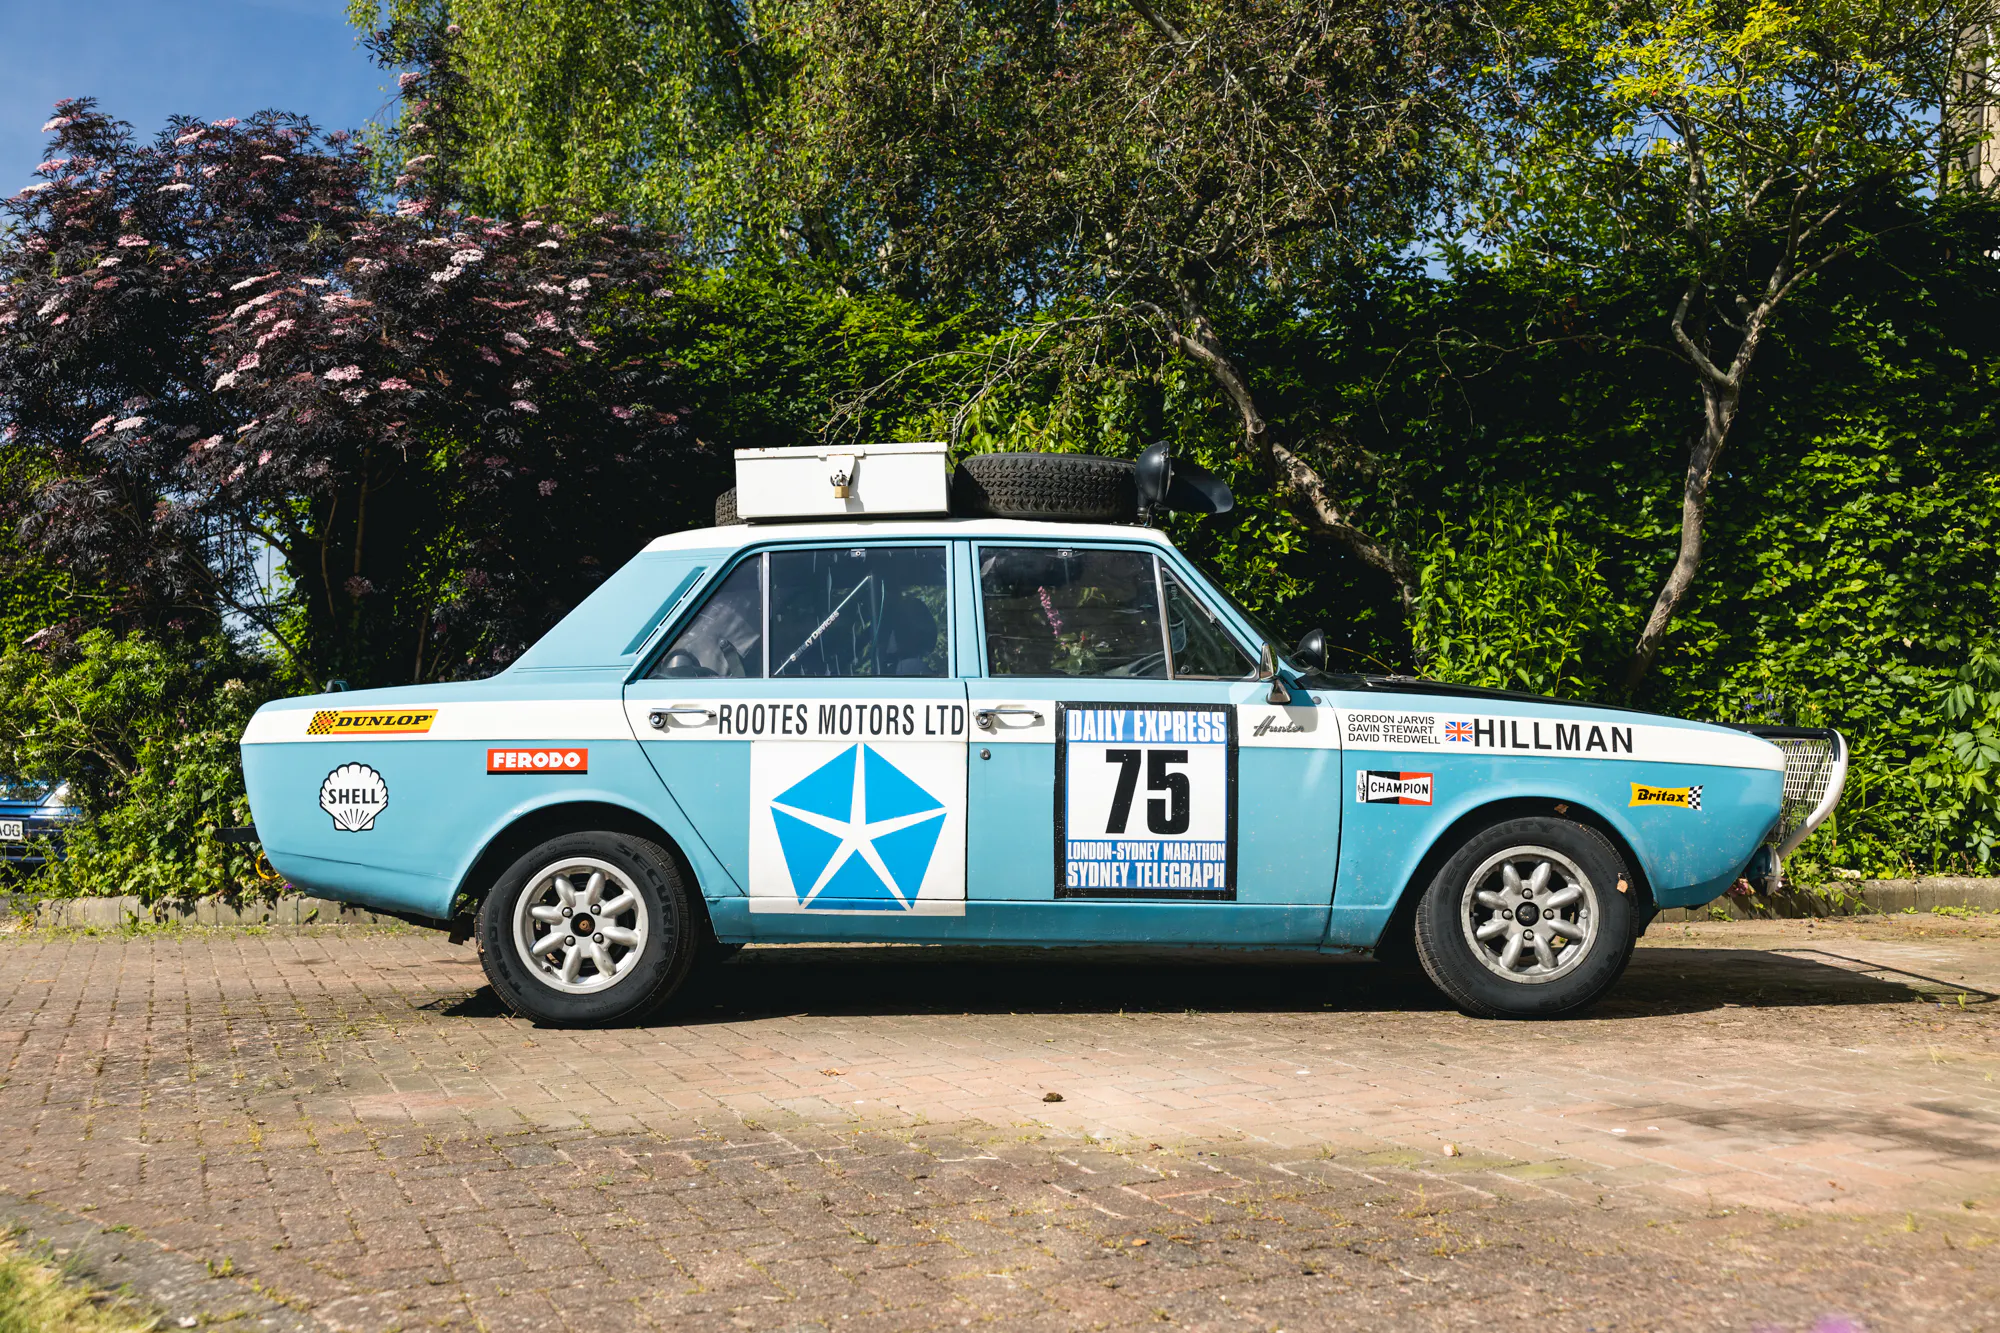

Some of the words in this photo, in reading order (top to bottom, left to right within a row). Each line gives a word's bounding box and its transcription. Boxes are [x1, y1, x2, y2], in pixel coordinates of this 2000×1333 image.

[811, 610, 840, 640] Devices
[335, 715, 430, 727] DUNLOP
[718, 703, 808, 735] ROOTES
[818, 704, 915, 735] MOTORS
[925, 705, 964, 735] LTD
[1068, 709, 1126, 741] DAILY
[1133, 711, 1226, 742] EXPRESS
[1252, 715, 1305, 737] Hunter
[1347, 714, 1395, 724] GORDON
[1397, 715, 1435, 725] JARVIS
[1347, 723, 1380, 733] GAVIN
[1382, 724, 1434, 735] STEWART
[1347, 733, 1380, 743] DAVID
[1382, 734, 1441, 745] TREDWELL
[1473, 718, 1633, 753] HILLMAN
[493, 752, 581, 768] FERODO
[328, 788, 380, 804] SHELL
[1105, 749, 1190, 835] 75
[1370, 781, 1429, 794] CHAMPION
[1637, 788, 1686, 803] Britax
[1067, 841, 1160, 860] LONDON-SYDNEY
[1163, 842, 1226, 861] MARATHON
[1439, 821, 1557, 905] SECURITY
[1067, 862, 1130, 887] SYDNEY
[1135, 862, 1225, 888] TELEGRAPH
[614, 842, 677, 979] SECURITY
